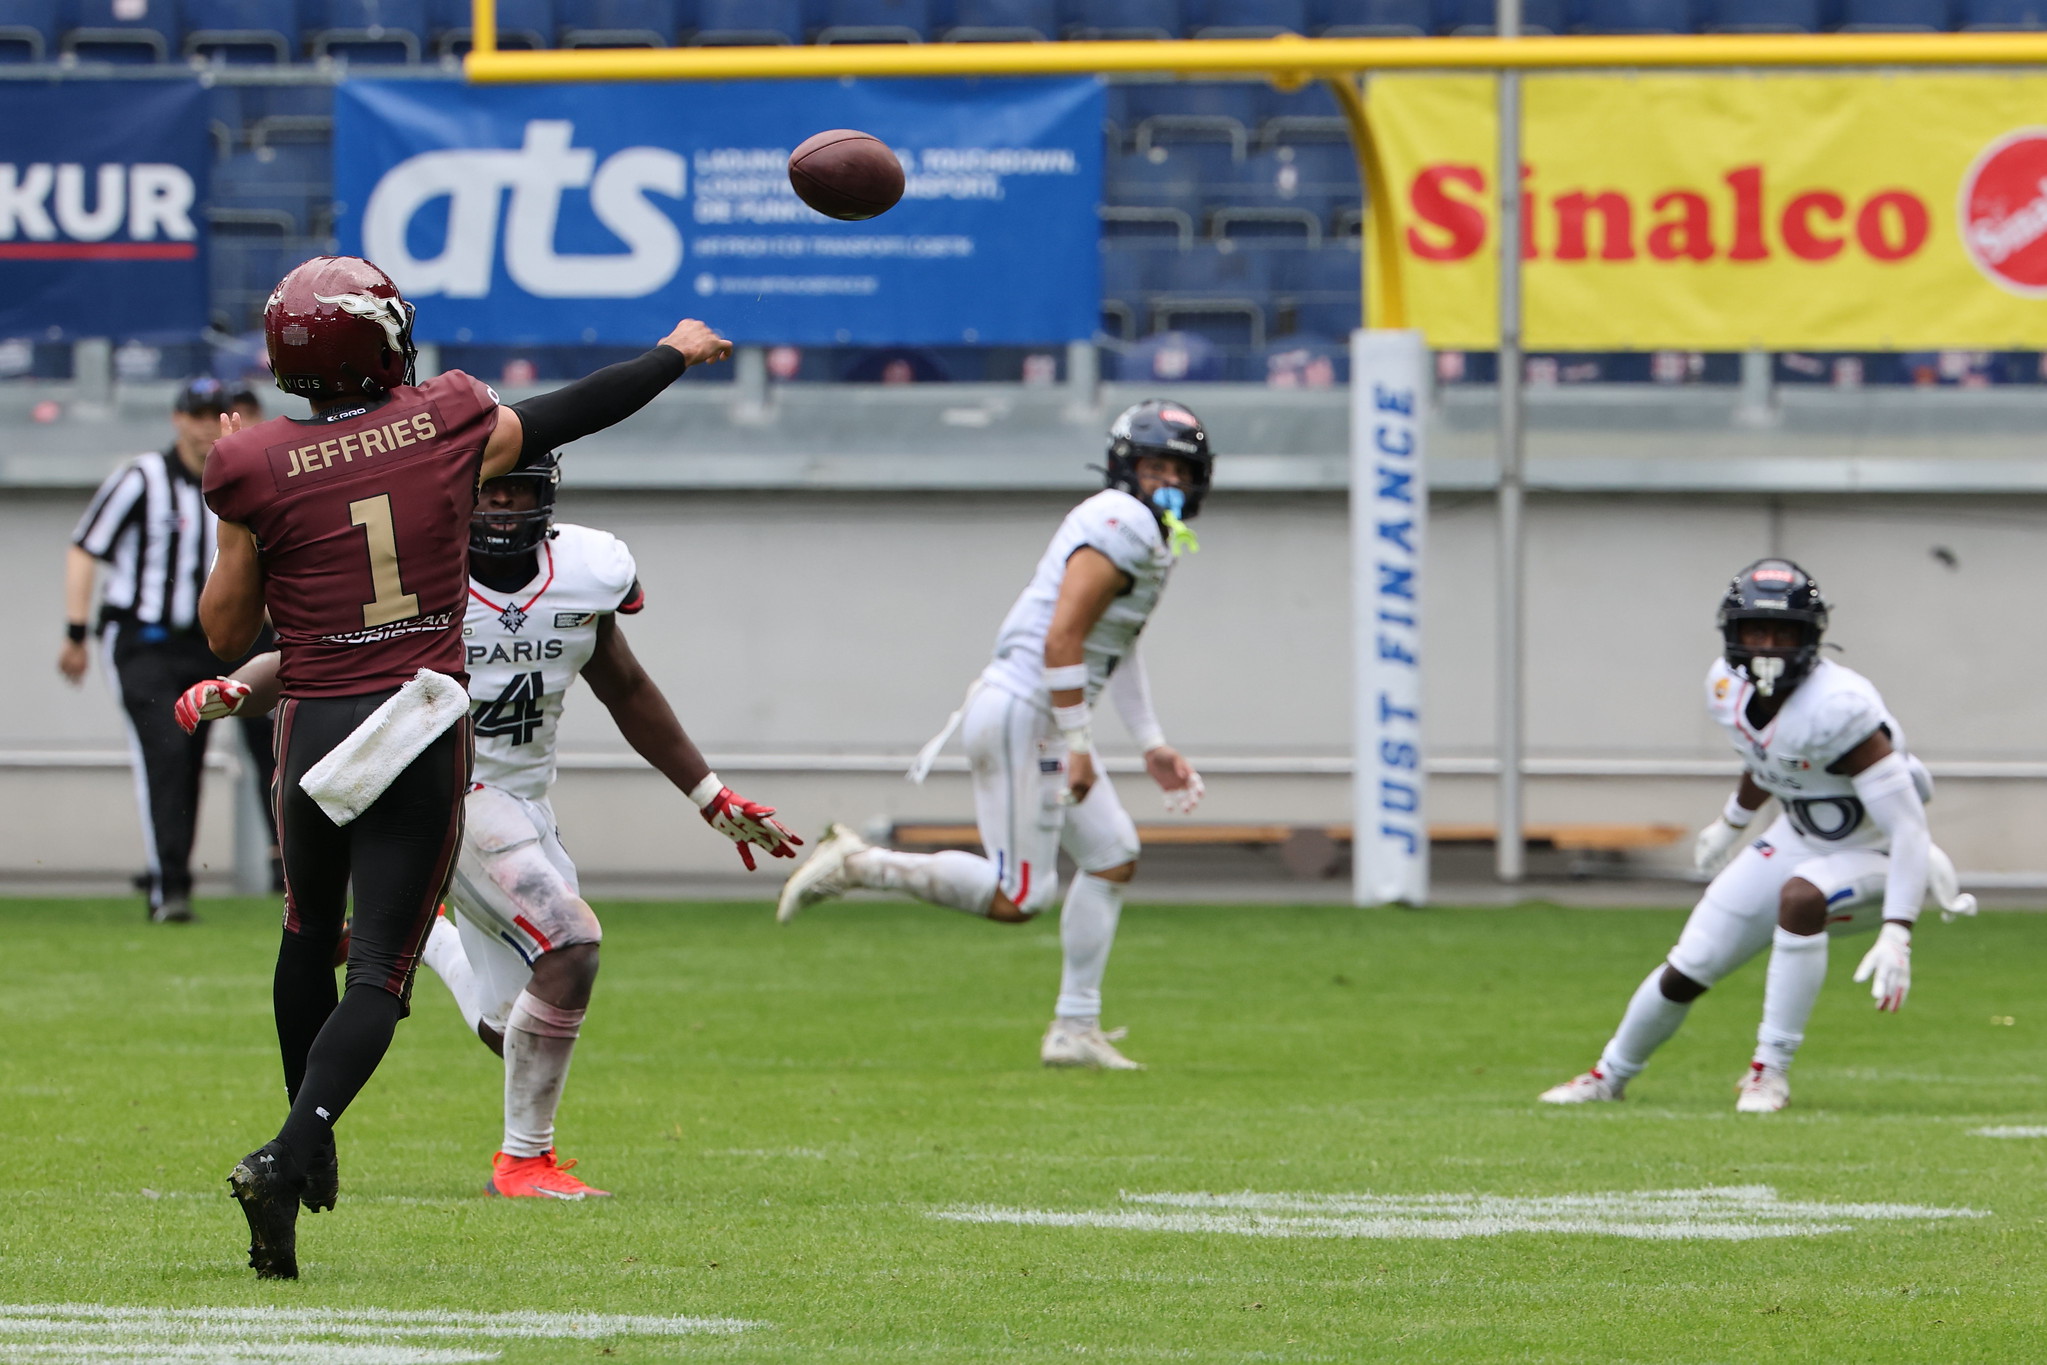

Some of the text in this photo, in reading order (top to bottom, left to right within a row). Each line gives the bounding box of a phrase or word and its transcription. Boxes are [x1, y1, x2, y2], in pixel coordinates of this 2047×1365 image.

[0, 162, 199, 243] KUR
[362, 119, 688, 299] ats
[284, 378, 321, 389] VICIS
[286, 412, 438, 479] JEFFRIES
[349, 493, 421, 629] 1
[466, 638, 563, 666] PARIS
[1375, 384, 1422, 856] JUST FINANCE
[473, 670, 545, 747] 4
